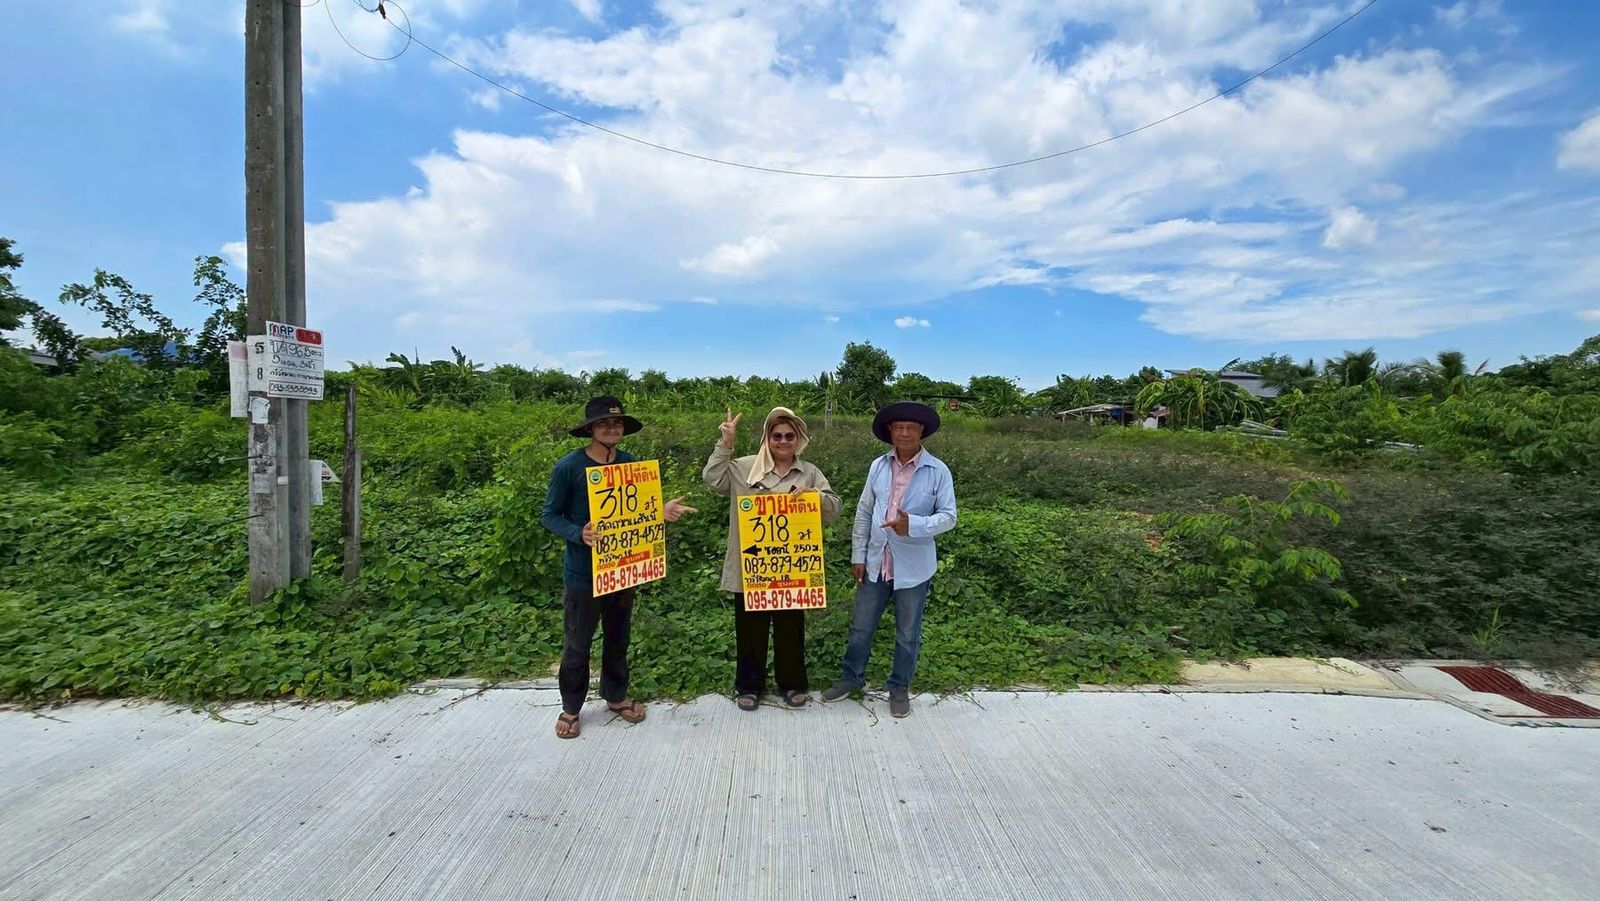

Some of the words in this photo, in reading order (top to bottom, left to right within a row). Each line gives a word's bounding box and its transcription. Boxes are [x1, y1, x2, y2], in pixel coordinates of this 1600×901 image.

[269, 323, 294, 335] MAP
[595, 483, 638, 519] 318
[596, 524, 664, 555] 083-879-4529
[749, 515, 790, 543] 318
[596, 557, 664, 594] 095-879-4465
[744, 554, 822, 574] 083-879-4529
[747, 588, 824, 609] 095-879-4465
